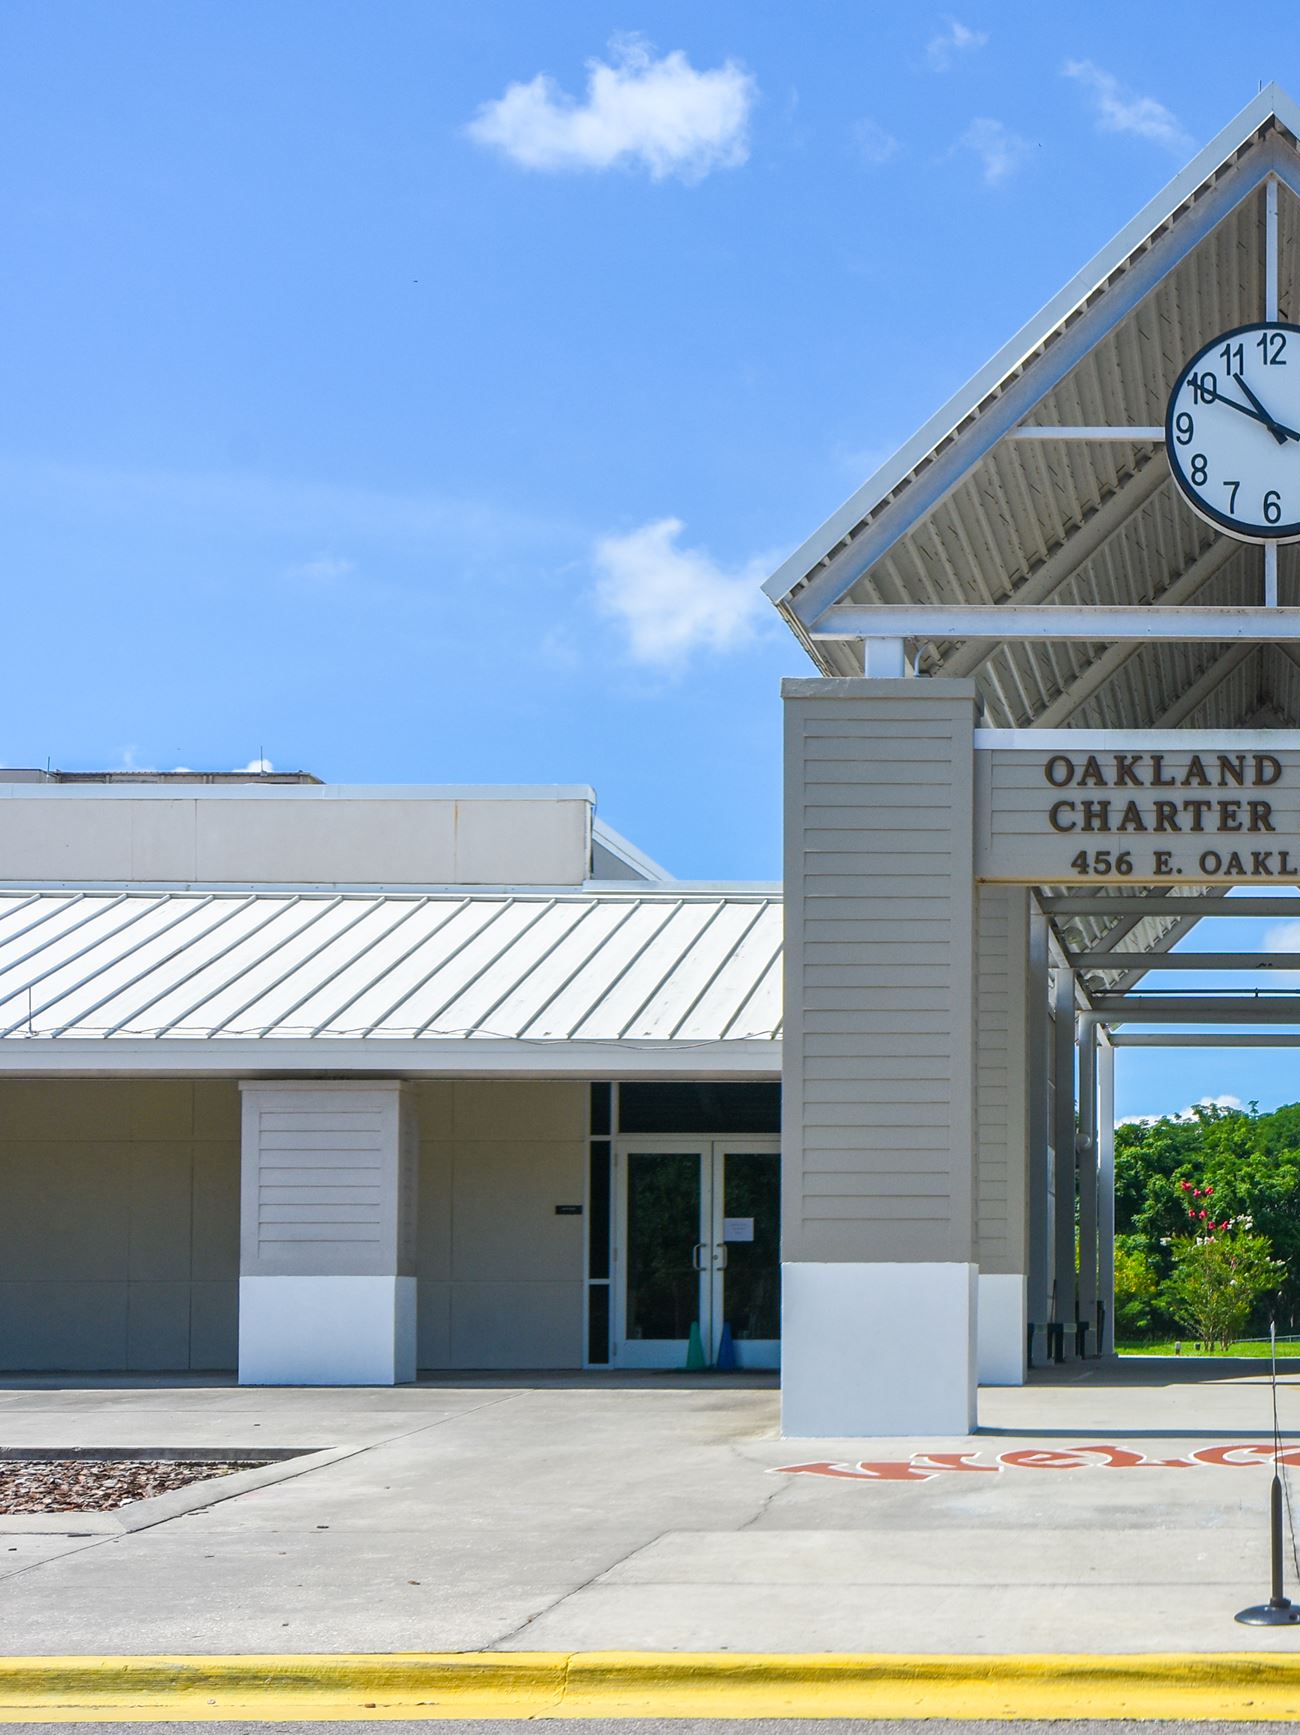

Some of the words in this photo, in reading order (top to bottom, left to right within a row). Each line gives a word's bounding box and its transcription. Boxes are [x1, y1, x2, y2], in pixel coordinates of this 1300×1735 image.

[1219, 343, 1244, 376] 11
[1256, 332, 1287, 366] 12
[1188, 372, 1218, 405] 10
[1175, 412, 1194, 446] 9
[1190, 453, 1208, 487] 8
[1223, 481, 1241, 515] 7
[1263, 490, 1281, 524] 6
[1044, 755, 1283, 787] OAKLAND
[1048, 800, 1275, 832] CHARTER
[1071, 850, 1133, 876] 456
[1153, 851, 1183, 876] E.
